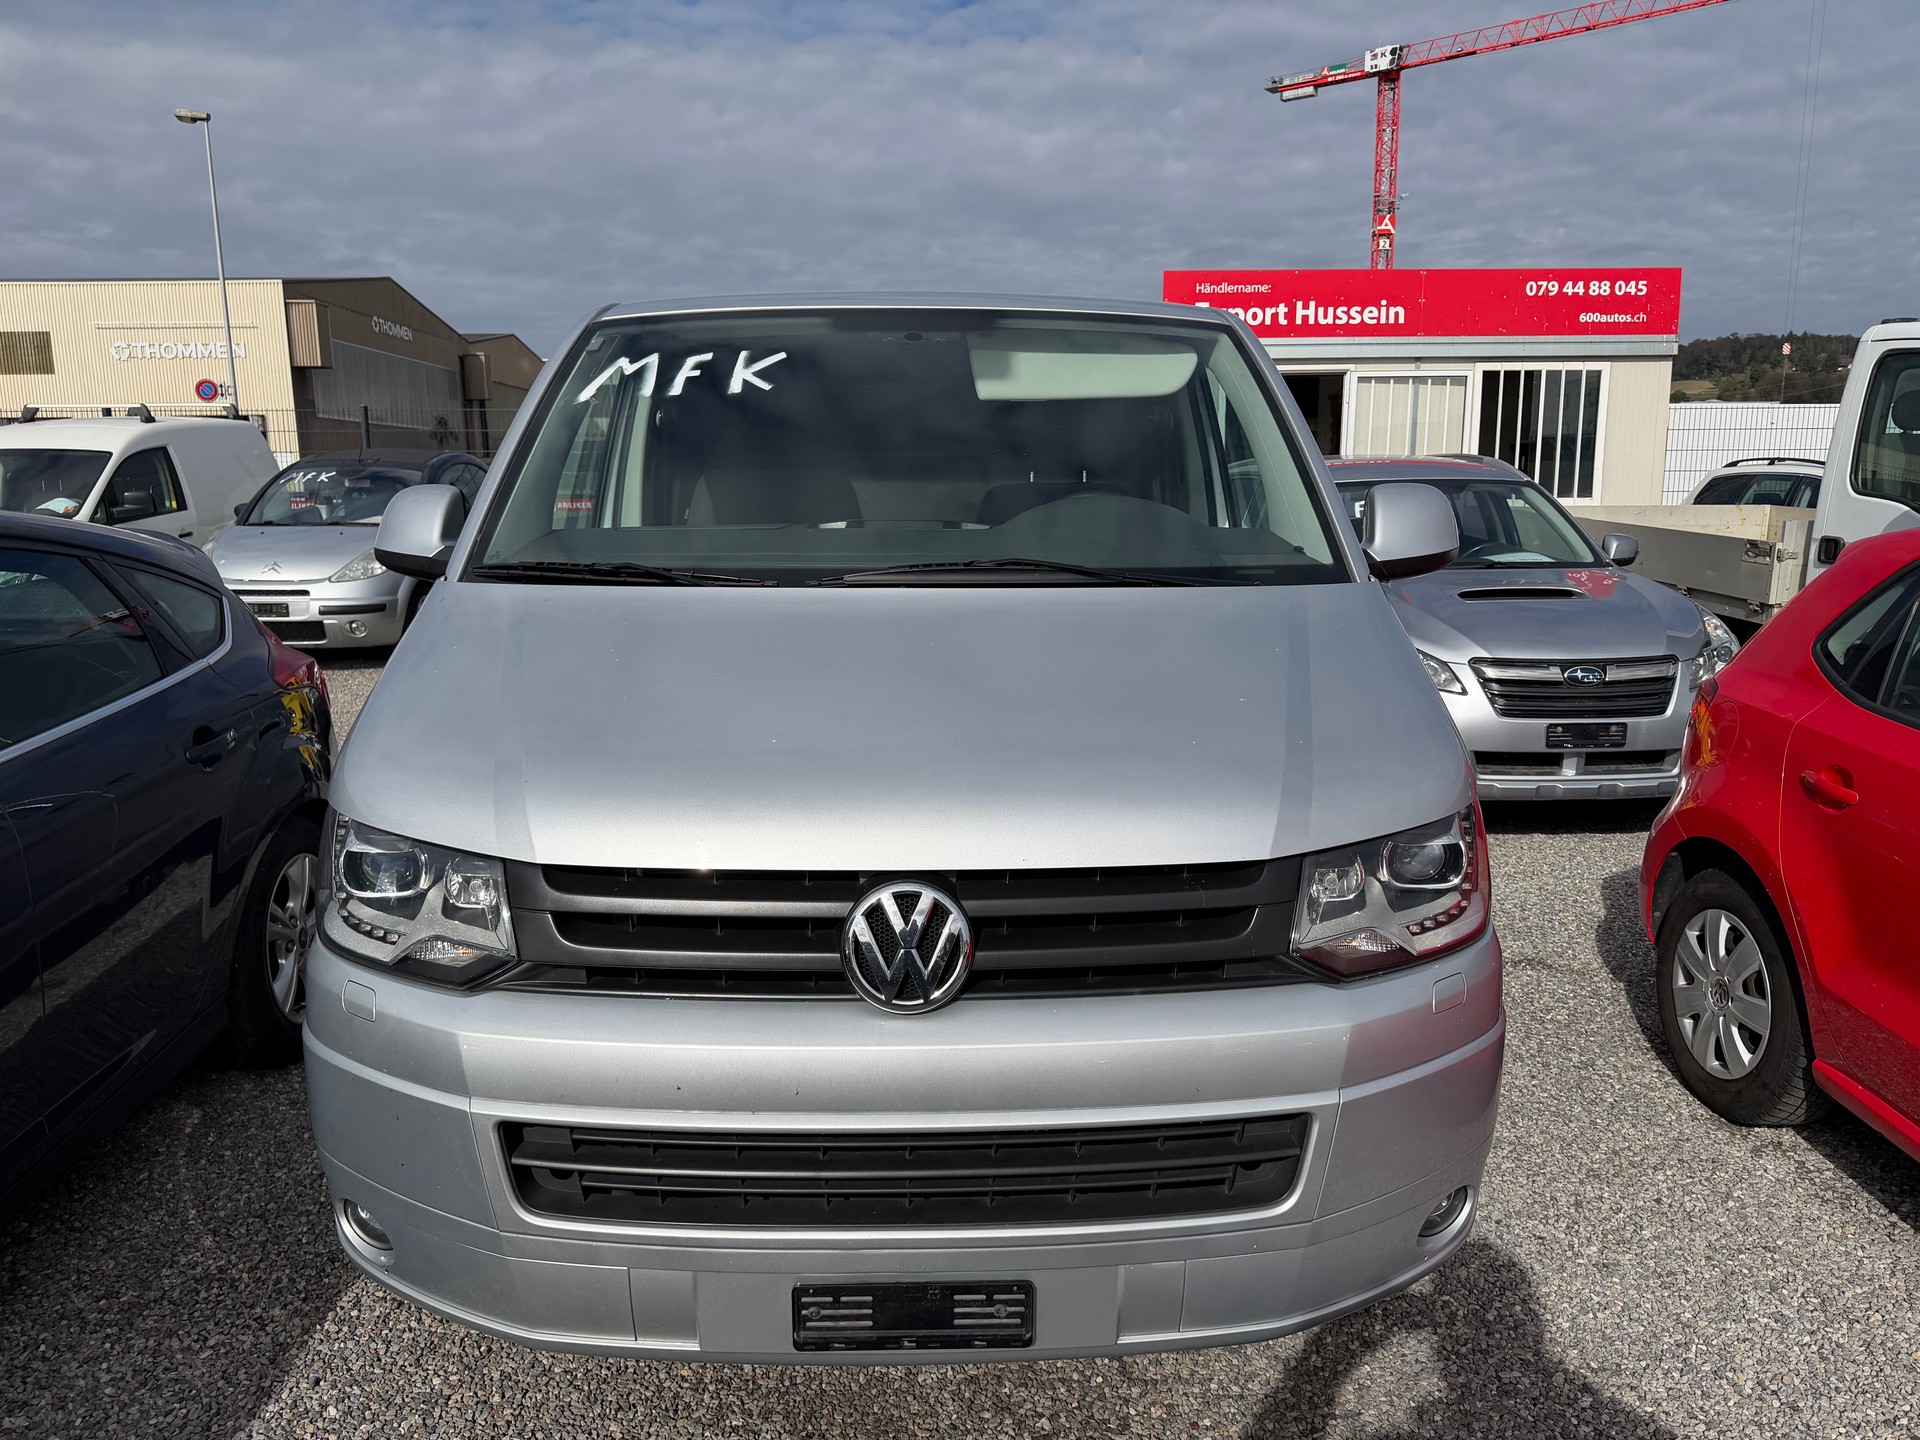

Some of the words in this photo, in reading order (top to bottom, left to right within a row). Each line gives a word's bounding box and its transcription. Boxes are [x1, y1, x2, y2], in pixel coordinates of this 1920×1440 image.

[1195, 282, 1272, 294] Händlername:
[1525, 280, 1559, 297] 079
[1562, 280, 1585, 296] 44
[1588, 280, 1611, 296] 88
[1614, 280, 1648, 296] 045
[1295, 299, 1406, 326] Hussein
[1579, 311, 1647, 323] 600autos.ch
[379, 318, 413, 342] THOMMEN
[131, 342, 247, 360] THOMMEN
[573, 350, 788, 405] MFK
